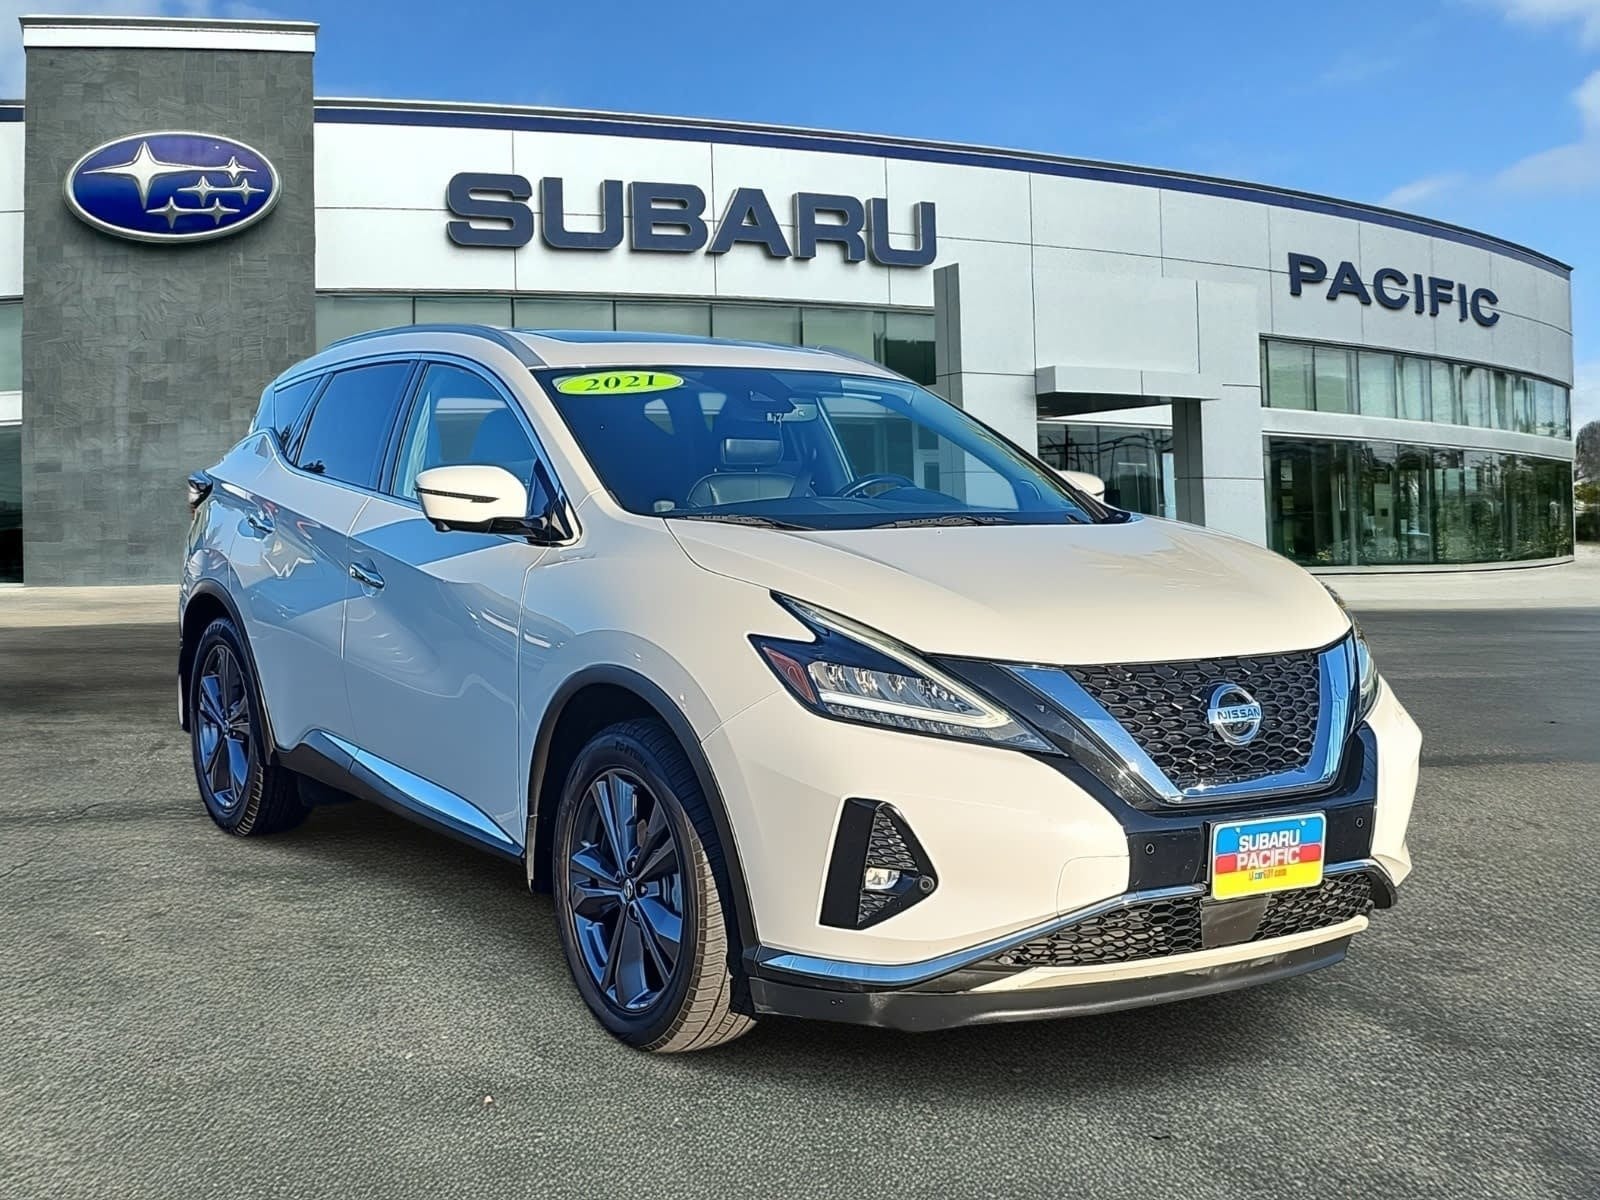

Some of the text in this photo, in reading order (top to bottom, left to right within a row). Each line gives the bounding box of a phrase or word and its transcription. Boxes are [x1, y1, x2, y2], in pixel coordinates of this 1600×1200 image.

[447, 171, 937, 267] SUBARU
[1288, 252, 1500, 327] PACIFIC
[584, 375, 655, 391] 2021
[1217, 708, 1261, 720] NISSAN
[1238, 829, 1300, 853] SUBARU
[1236, 847, 1301, 872] PACIFIC
